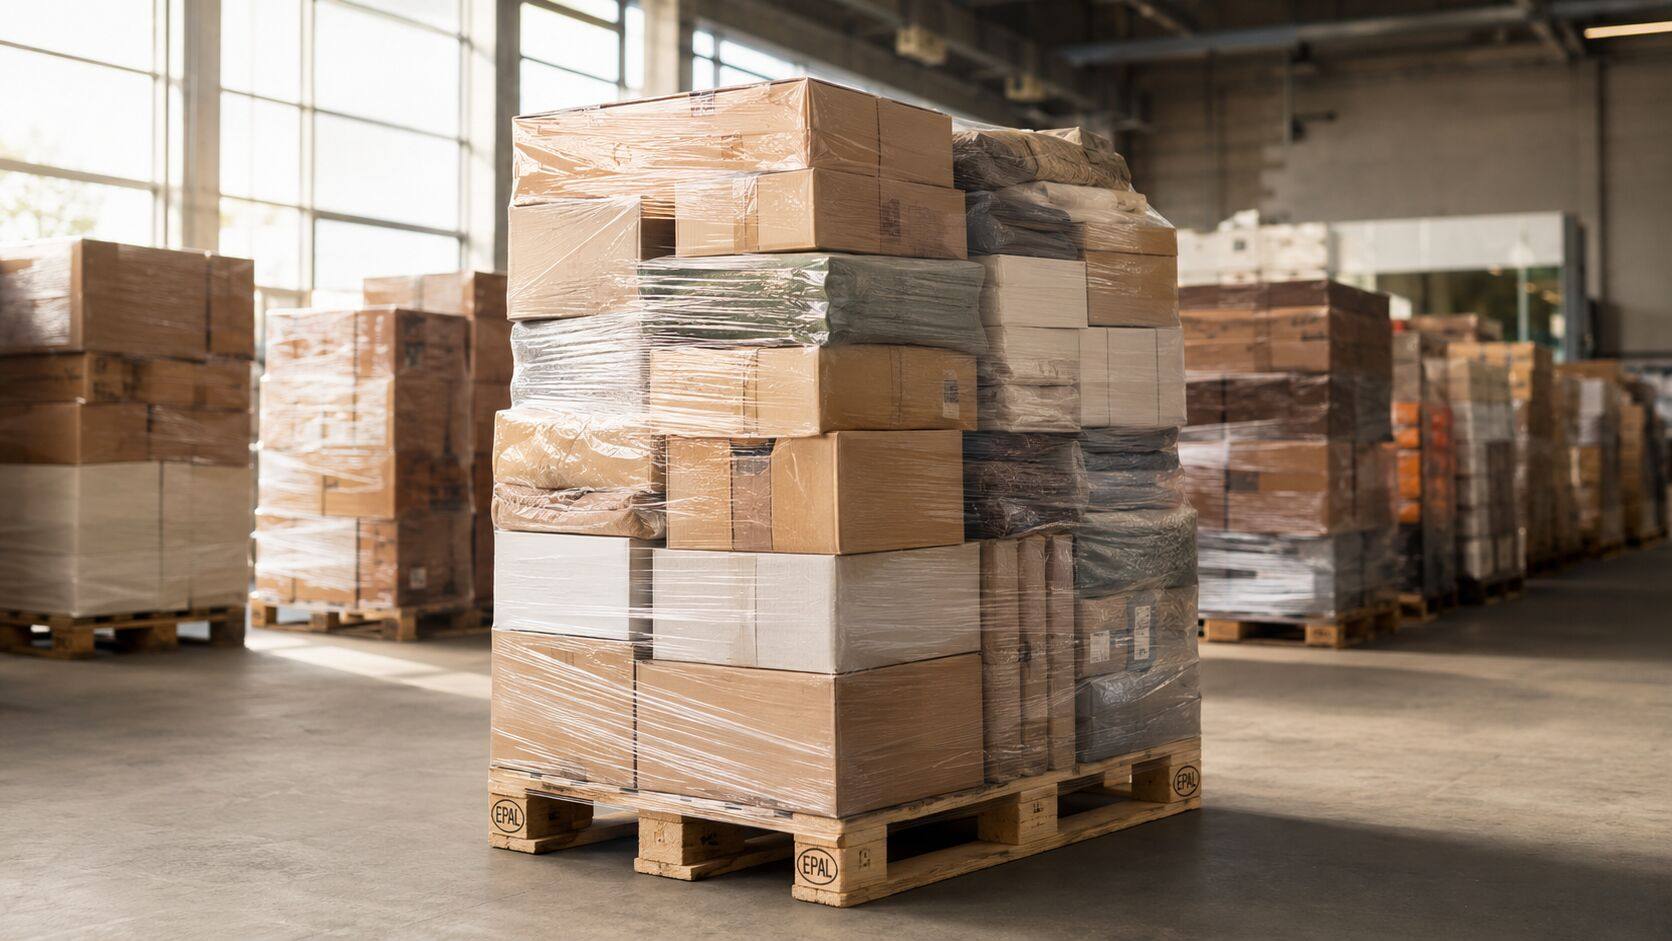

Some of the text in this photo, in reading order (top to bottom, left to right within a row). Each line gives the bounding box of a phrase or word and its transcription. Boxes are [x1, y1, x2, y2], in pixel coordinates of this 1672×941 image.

[1177, 770, 1196, 790] EPAL
[496, 805, 520, 827] EPAL
[803, 855, 832, 878] EPAL
